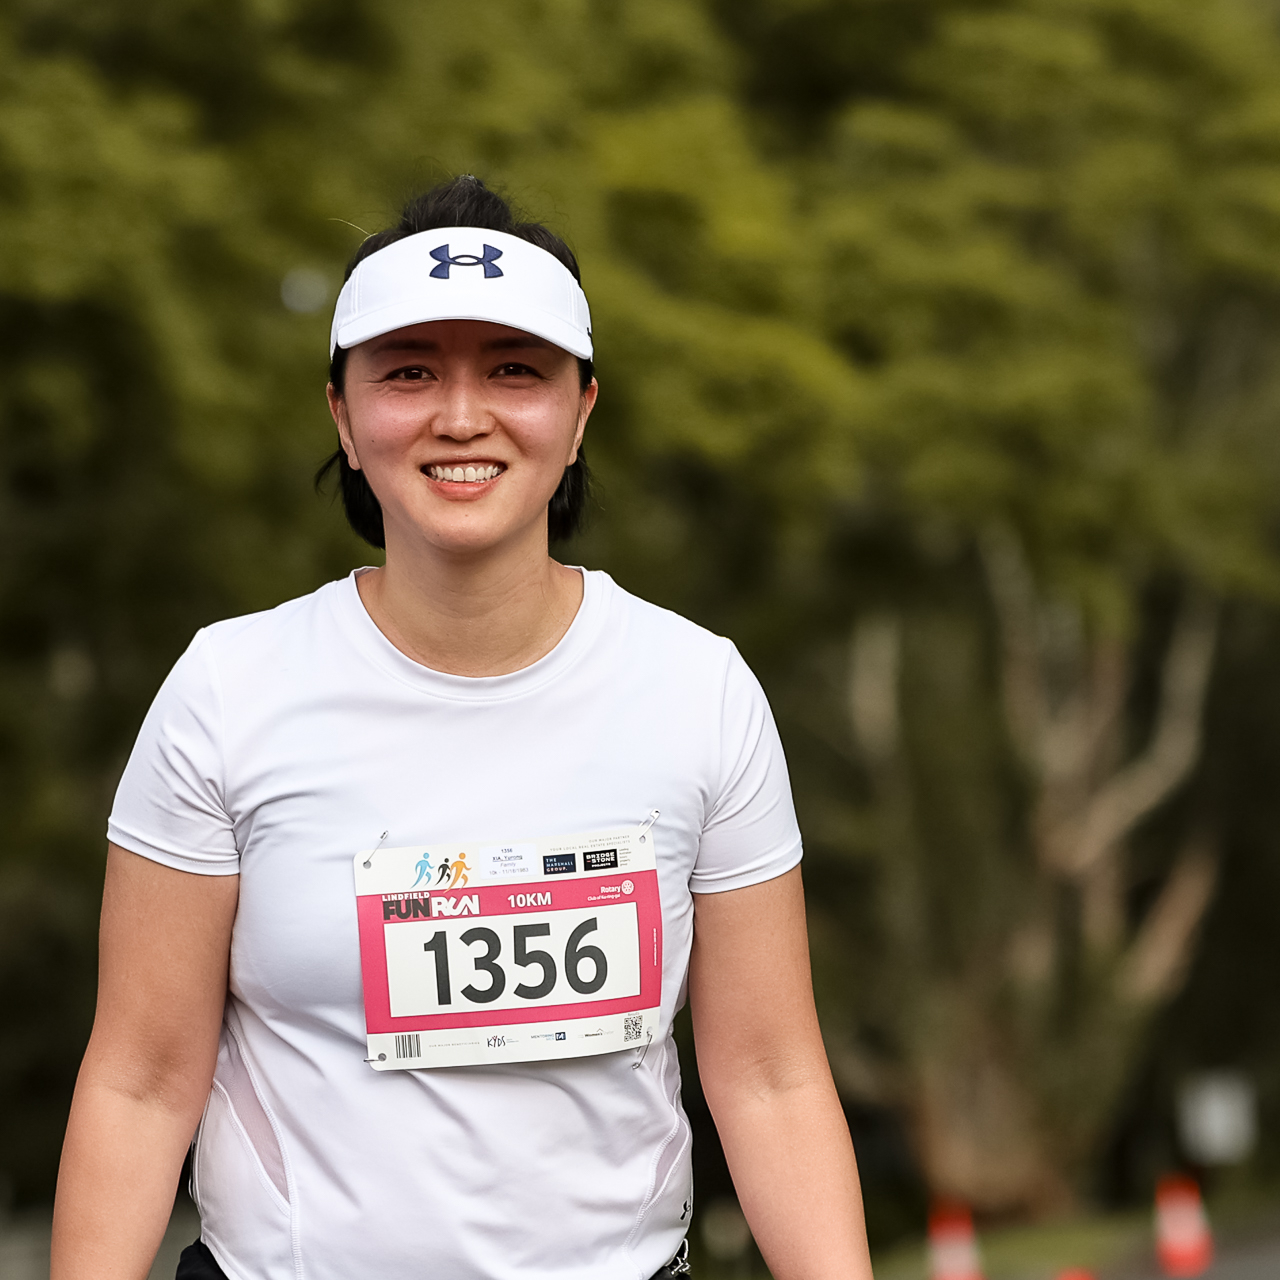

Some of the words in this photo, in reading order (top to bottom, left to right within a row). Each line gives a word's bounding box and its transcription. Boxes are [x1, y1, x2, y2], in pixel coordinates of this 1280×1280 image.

[585, 851, 615, 860] BRIDGE
[600, 886, 620, 894] Rotary
[382, 892, 430, 902] LINDFIELD
[507, 892, 552, 908] 10KM
[383, 898, 430, 921] FUN
[431, 894, 480, 918] RUN
[424, 917, 608, 1006] 1356
